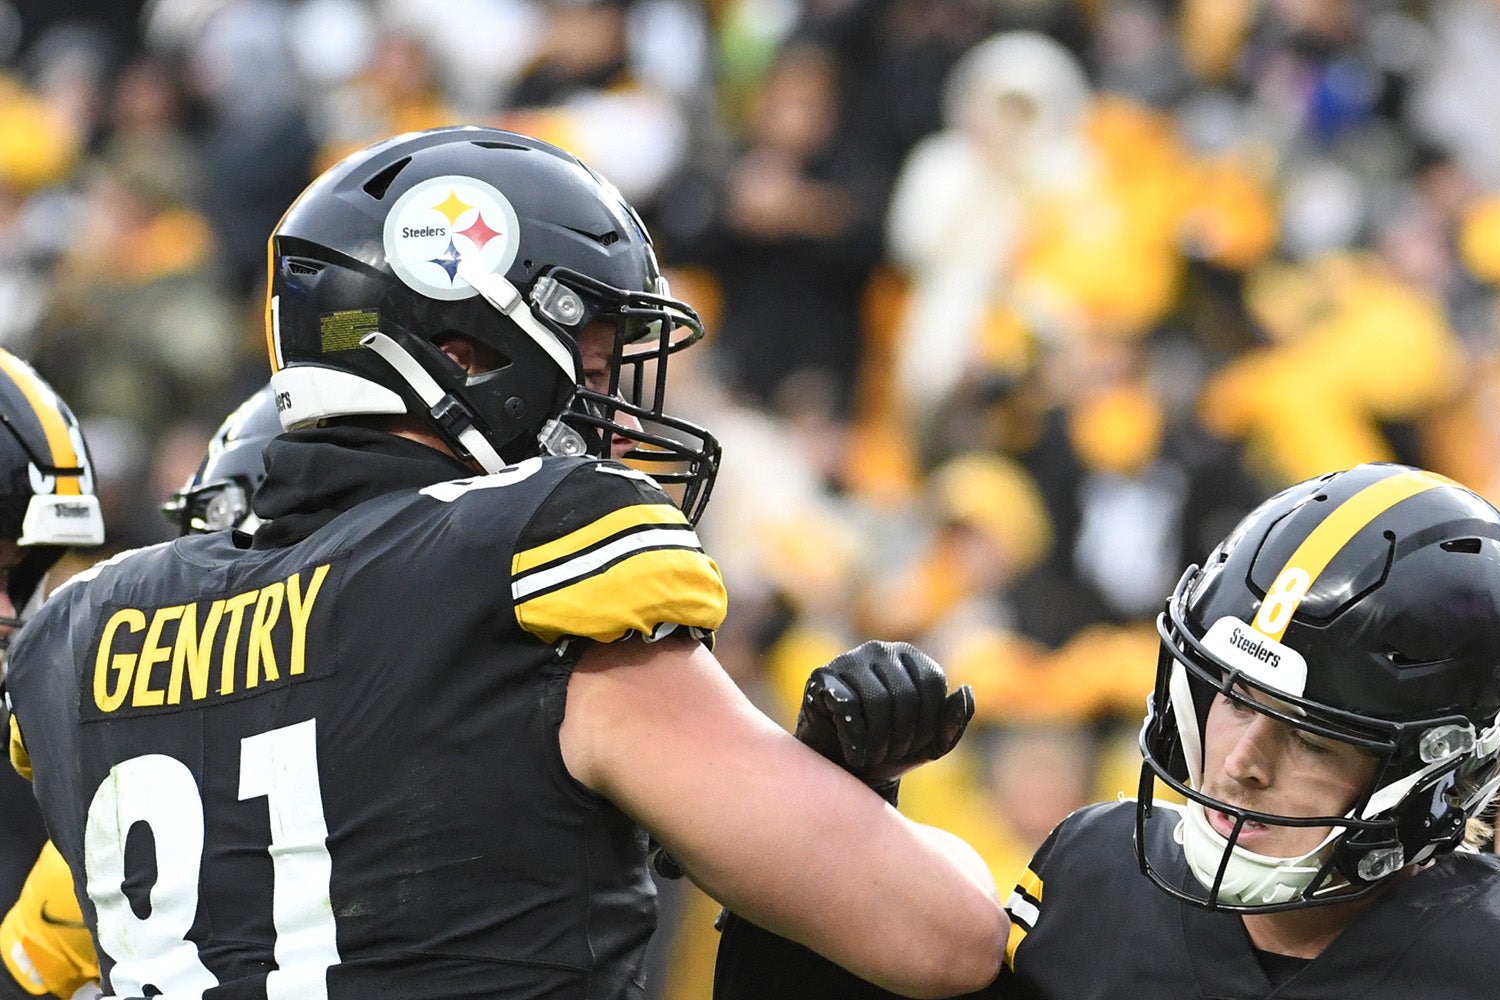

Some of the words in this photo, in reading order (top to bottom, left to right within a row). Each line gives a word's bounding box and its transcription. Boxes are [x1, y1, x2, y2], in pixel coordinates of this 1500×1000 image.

[402, 226, 446, 239] Steelers
[1257, 567, 1311, 635] 8
[93, 564, 331, 713] GENTRY
[1229, 627, 1282, 668] Steelers
